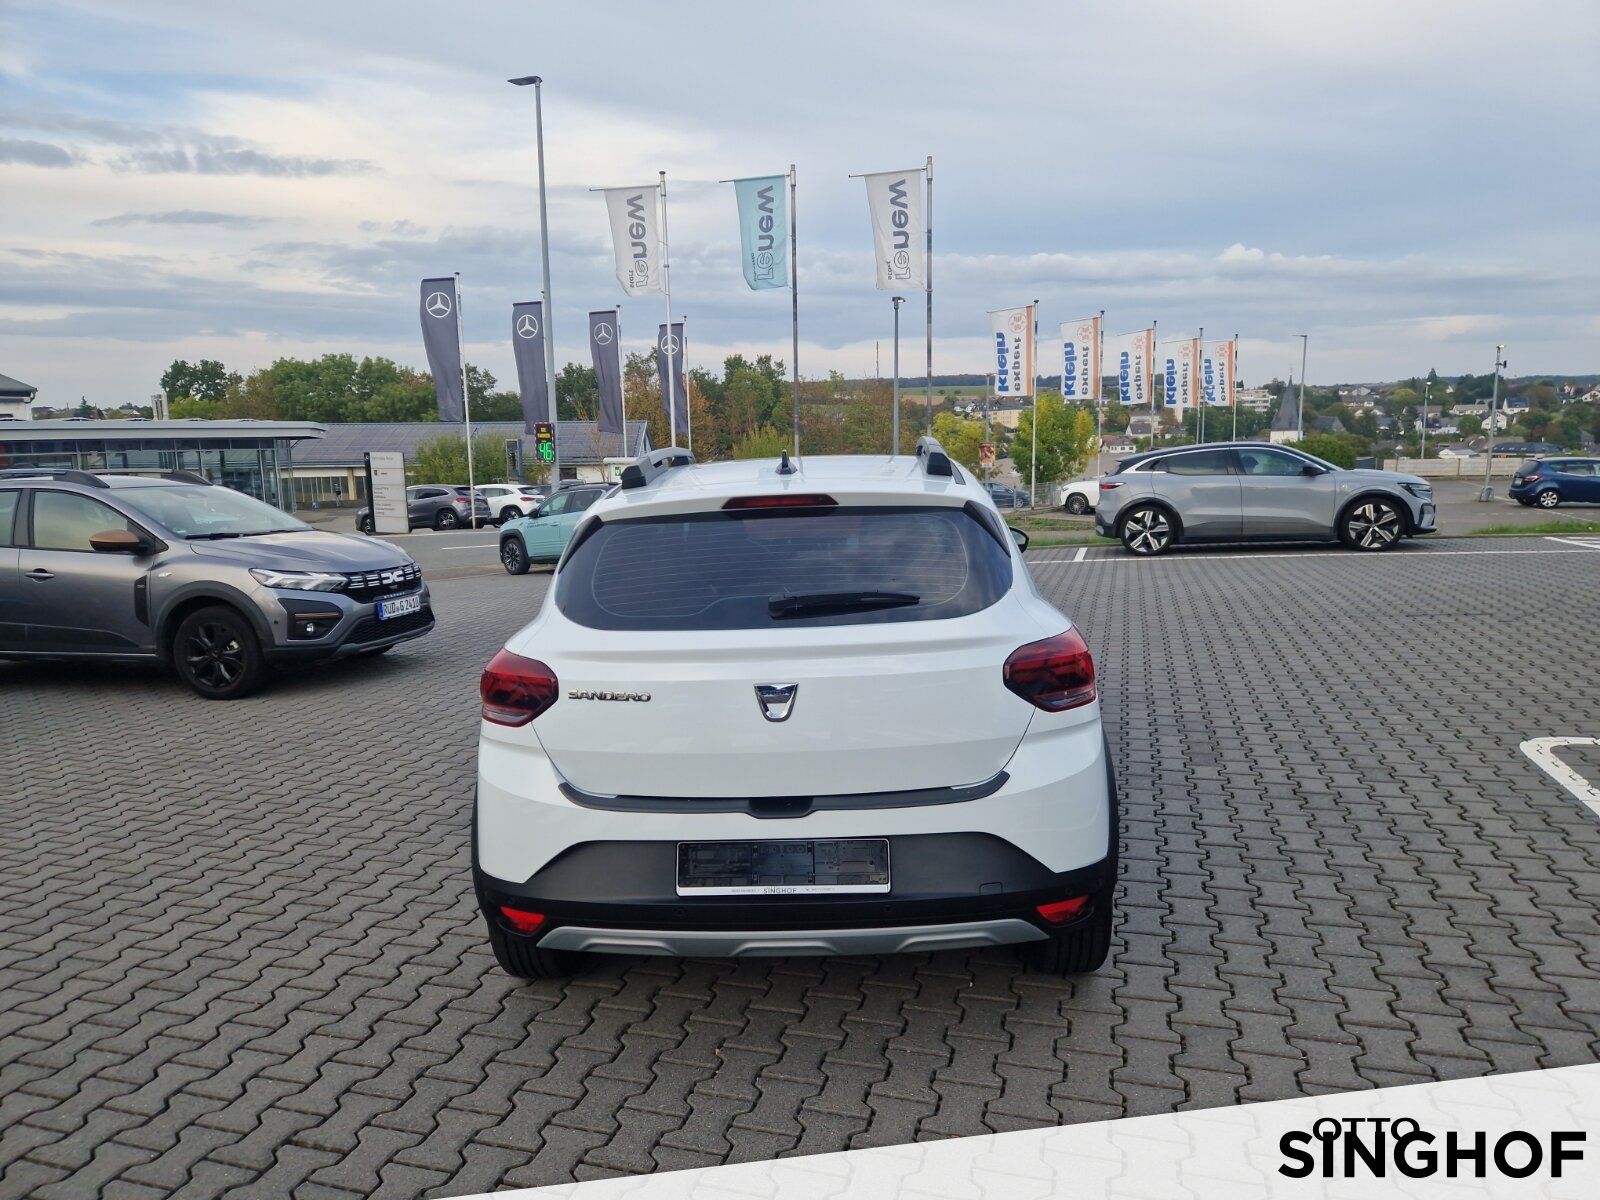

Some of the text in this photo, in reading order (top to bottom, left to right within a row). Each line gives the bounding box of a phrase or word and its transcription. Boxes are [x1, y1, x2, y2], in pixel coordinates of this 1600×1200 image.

[539, 442, 552, 460] 46
[568, 689, 652, 702] SANDERO
[763, 887, 798, 895] SINGHOF
